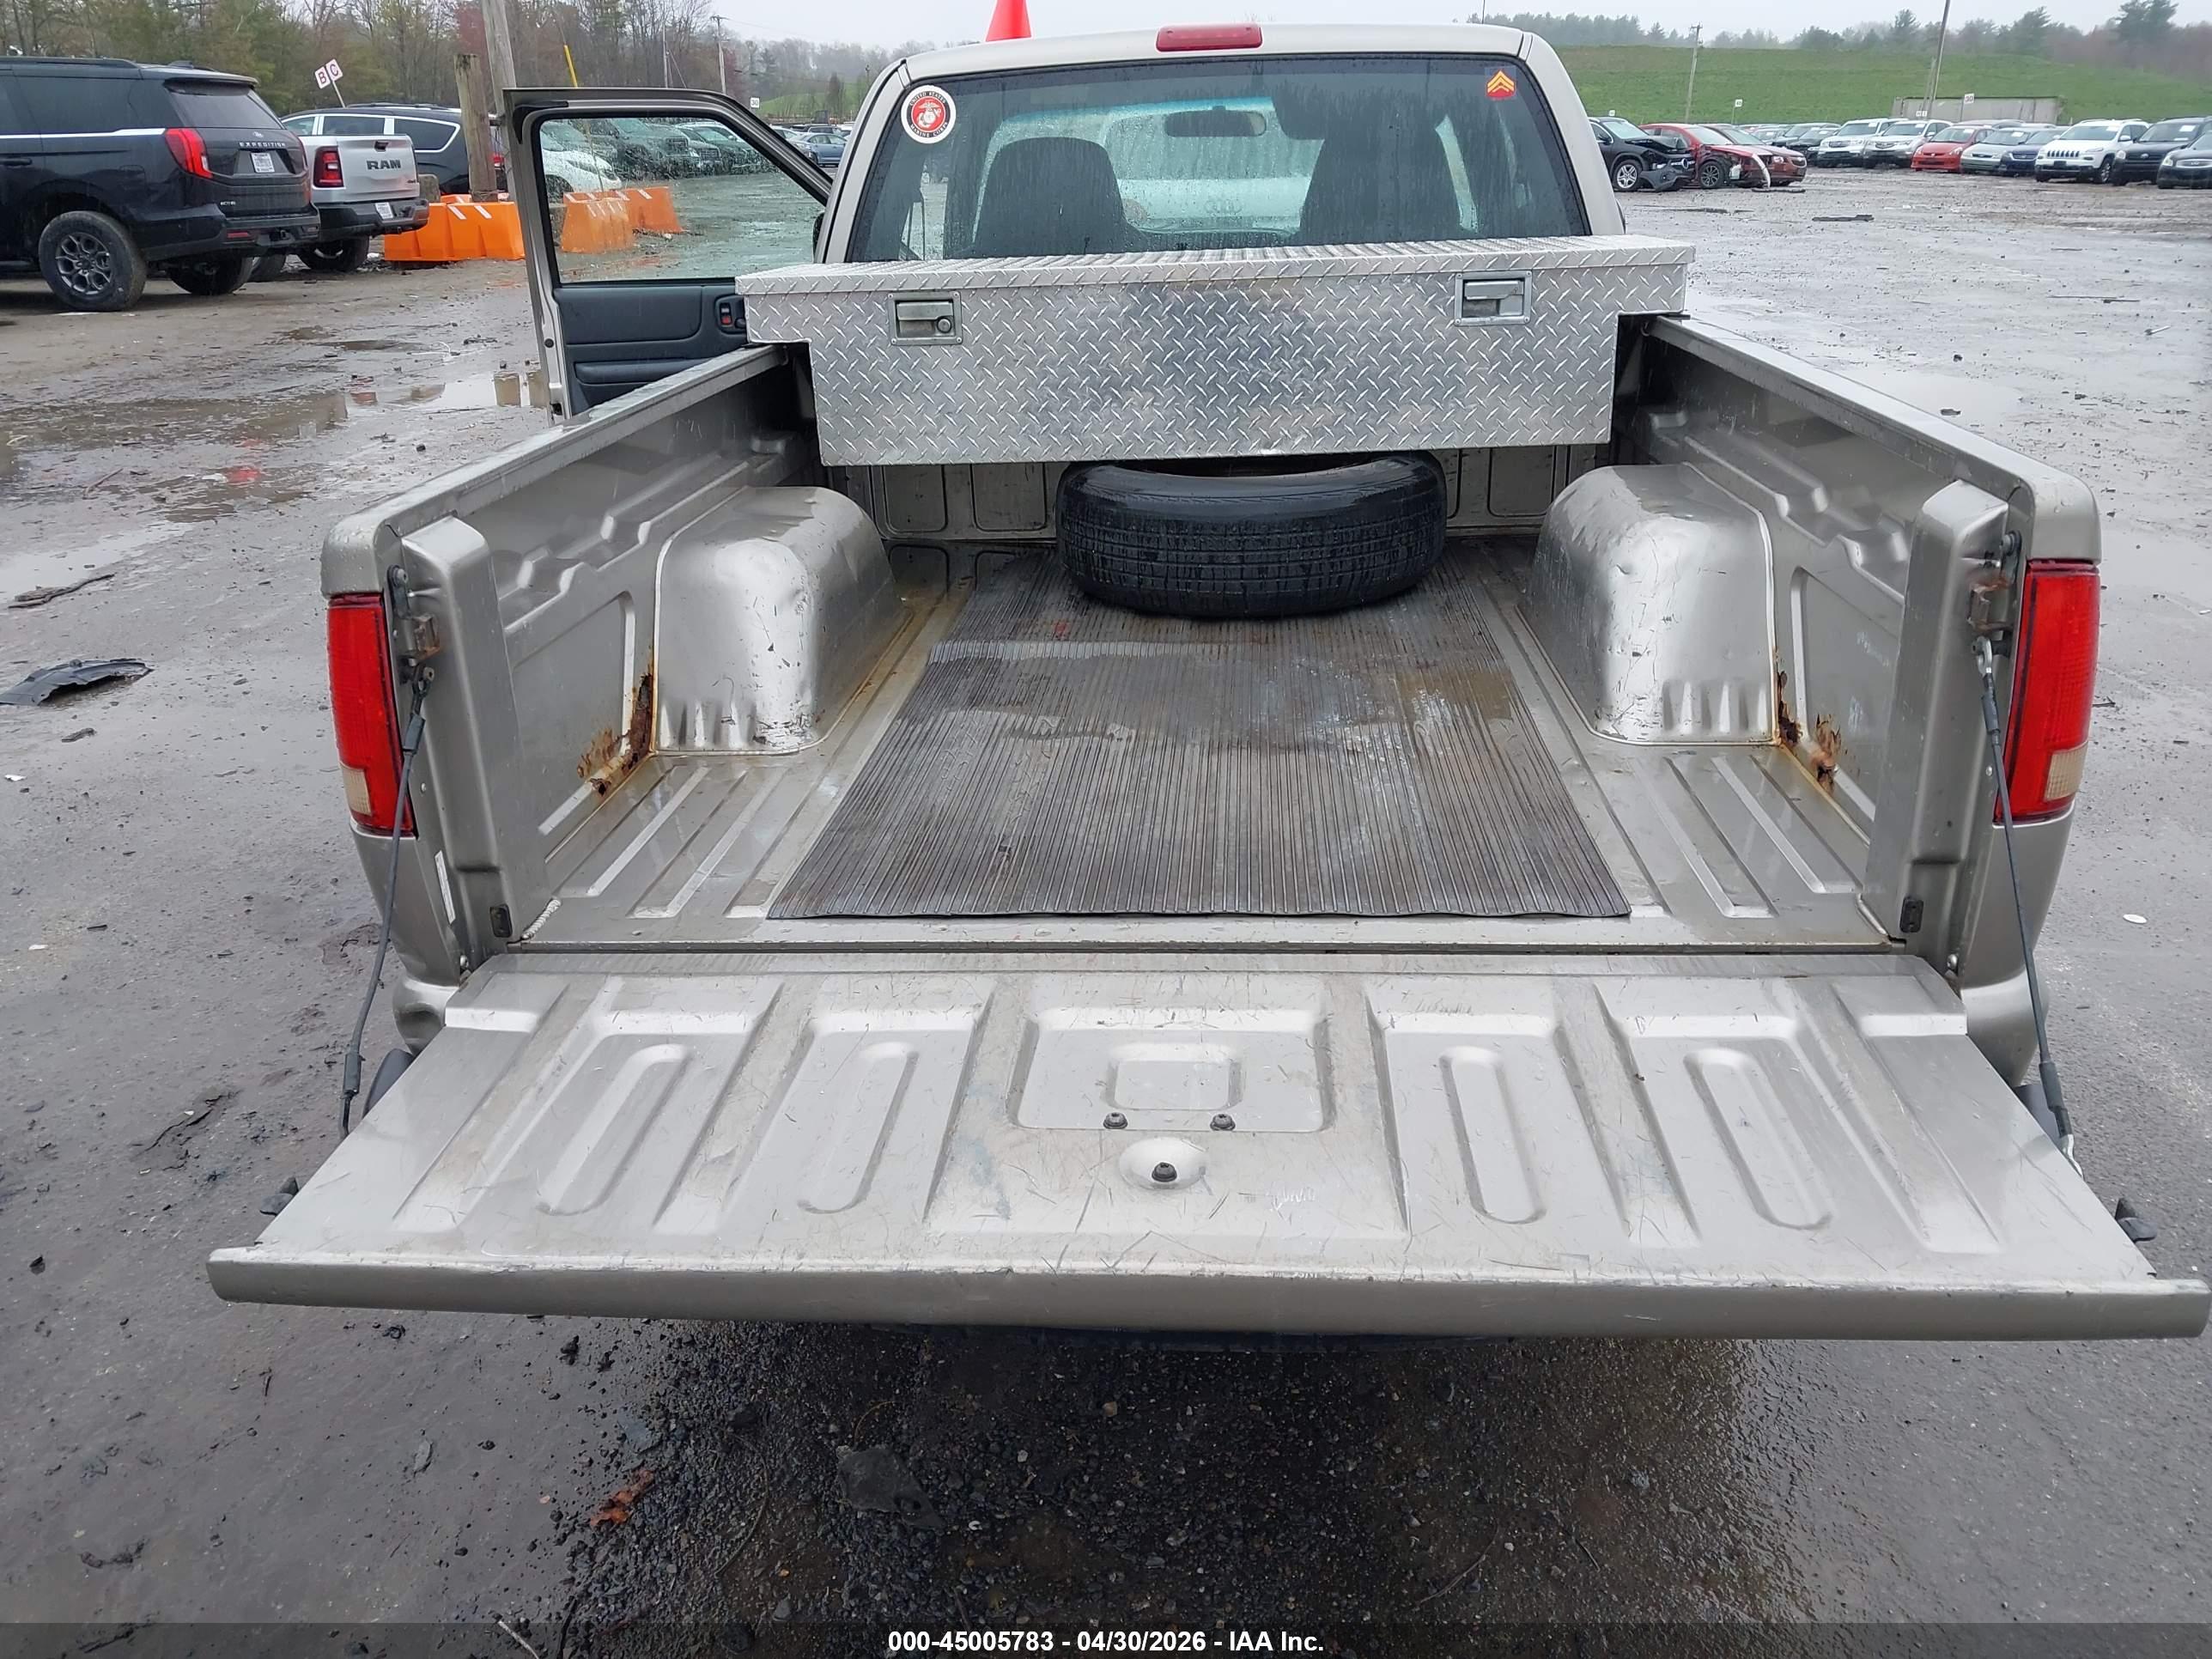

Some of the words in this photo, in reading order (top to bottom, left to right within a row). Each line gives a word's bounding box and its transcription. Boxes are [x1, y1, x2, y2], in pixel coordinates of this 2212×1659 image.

[318, 71, 327, 84] B
[330, 64, 339, 76] C
[910, 124, 930, 137] MARINE
[367, 160, 401, 170] RAM
